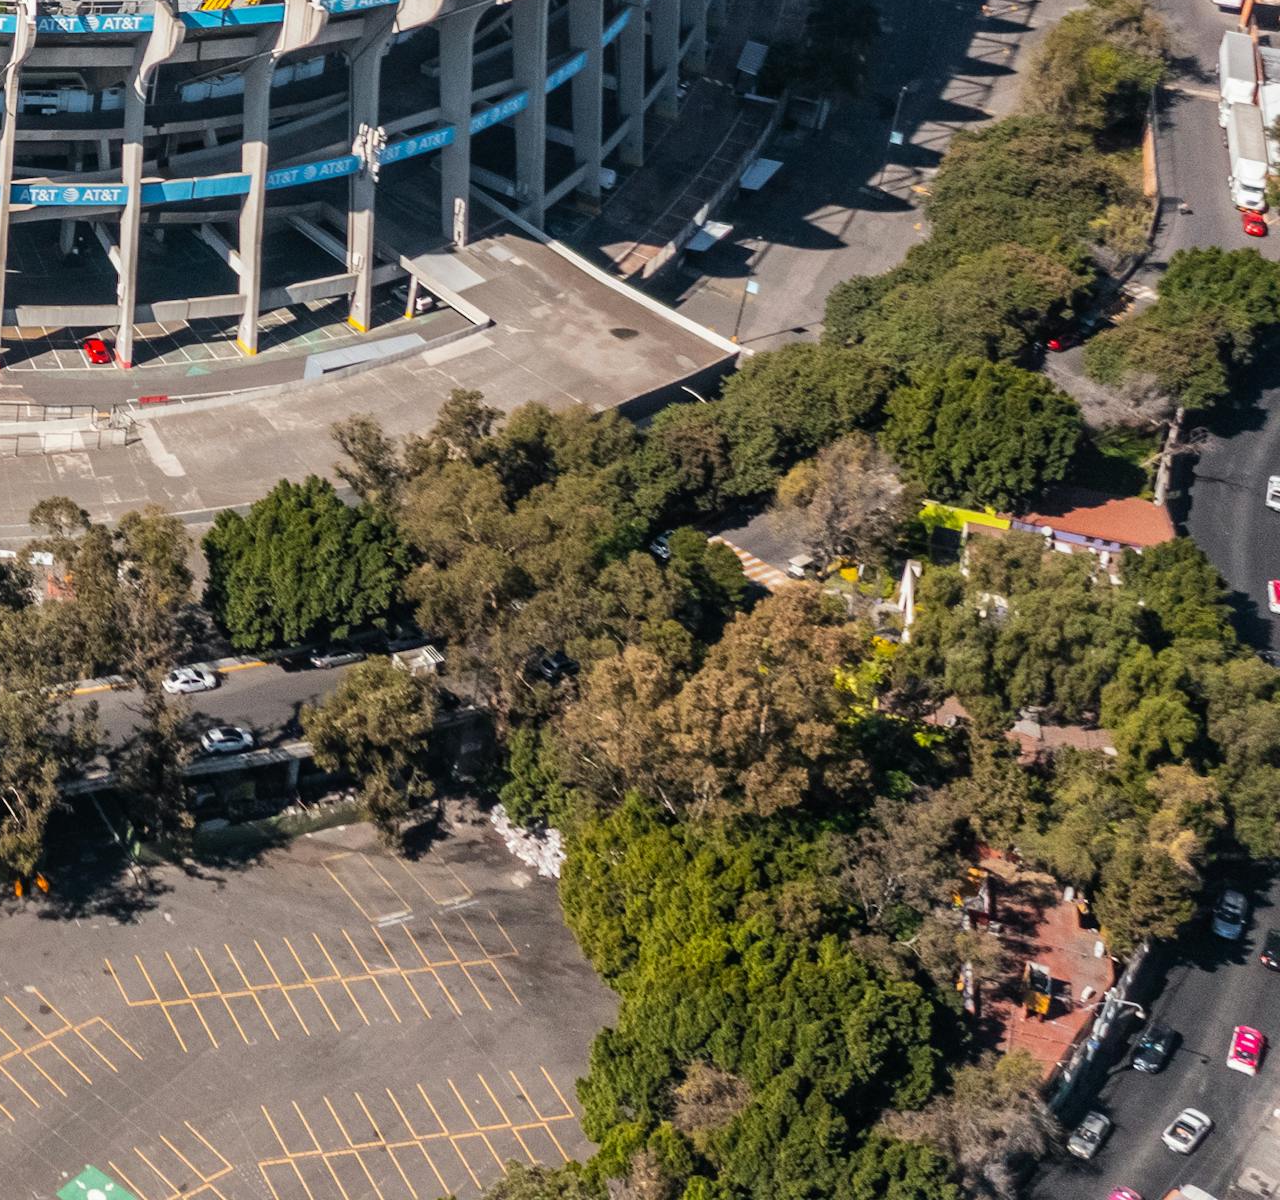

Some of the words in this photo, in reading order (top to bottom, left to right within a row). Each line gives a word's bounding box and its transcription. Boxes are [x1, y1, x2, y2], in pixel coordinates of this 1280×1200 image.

[39, 16, 77, 32] AT&T
[102, 16, 142, 30] AT&T
[419, 131, 448, 149] AT&T
[267, 169, 299, 186] AT&T
[320, 159, 352, 176] AT&T
[20, 189, 56, 202] AT&T
[82, 189, 121, 201] AT&T
